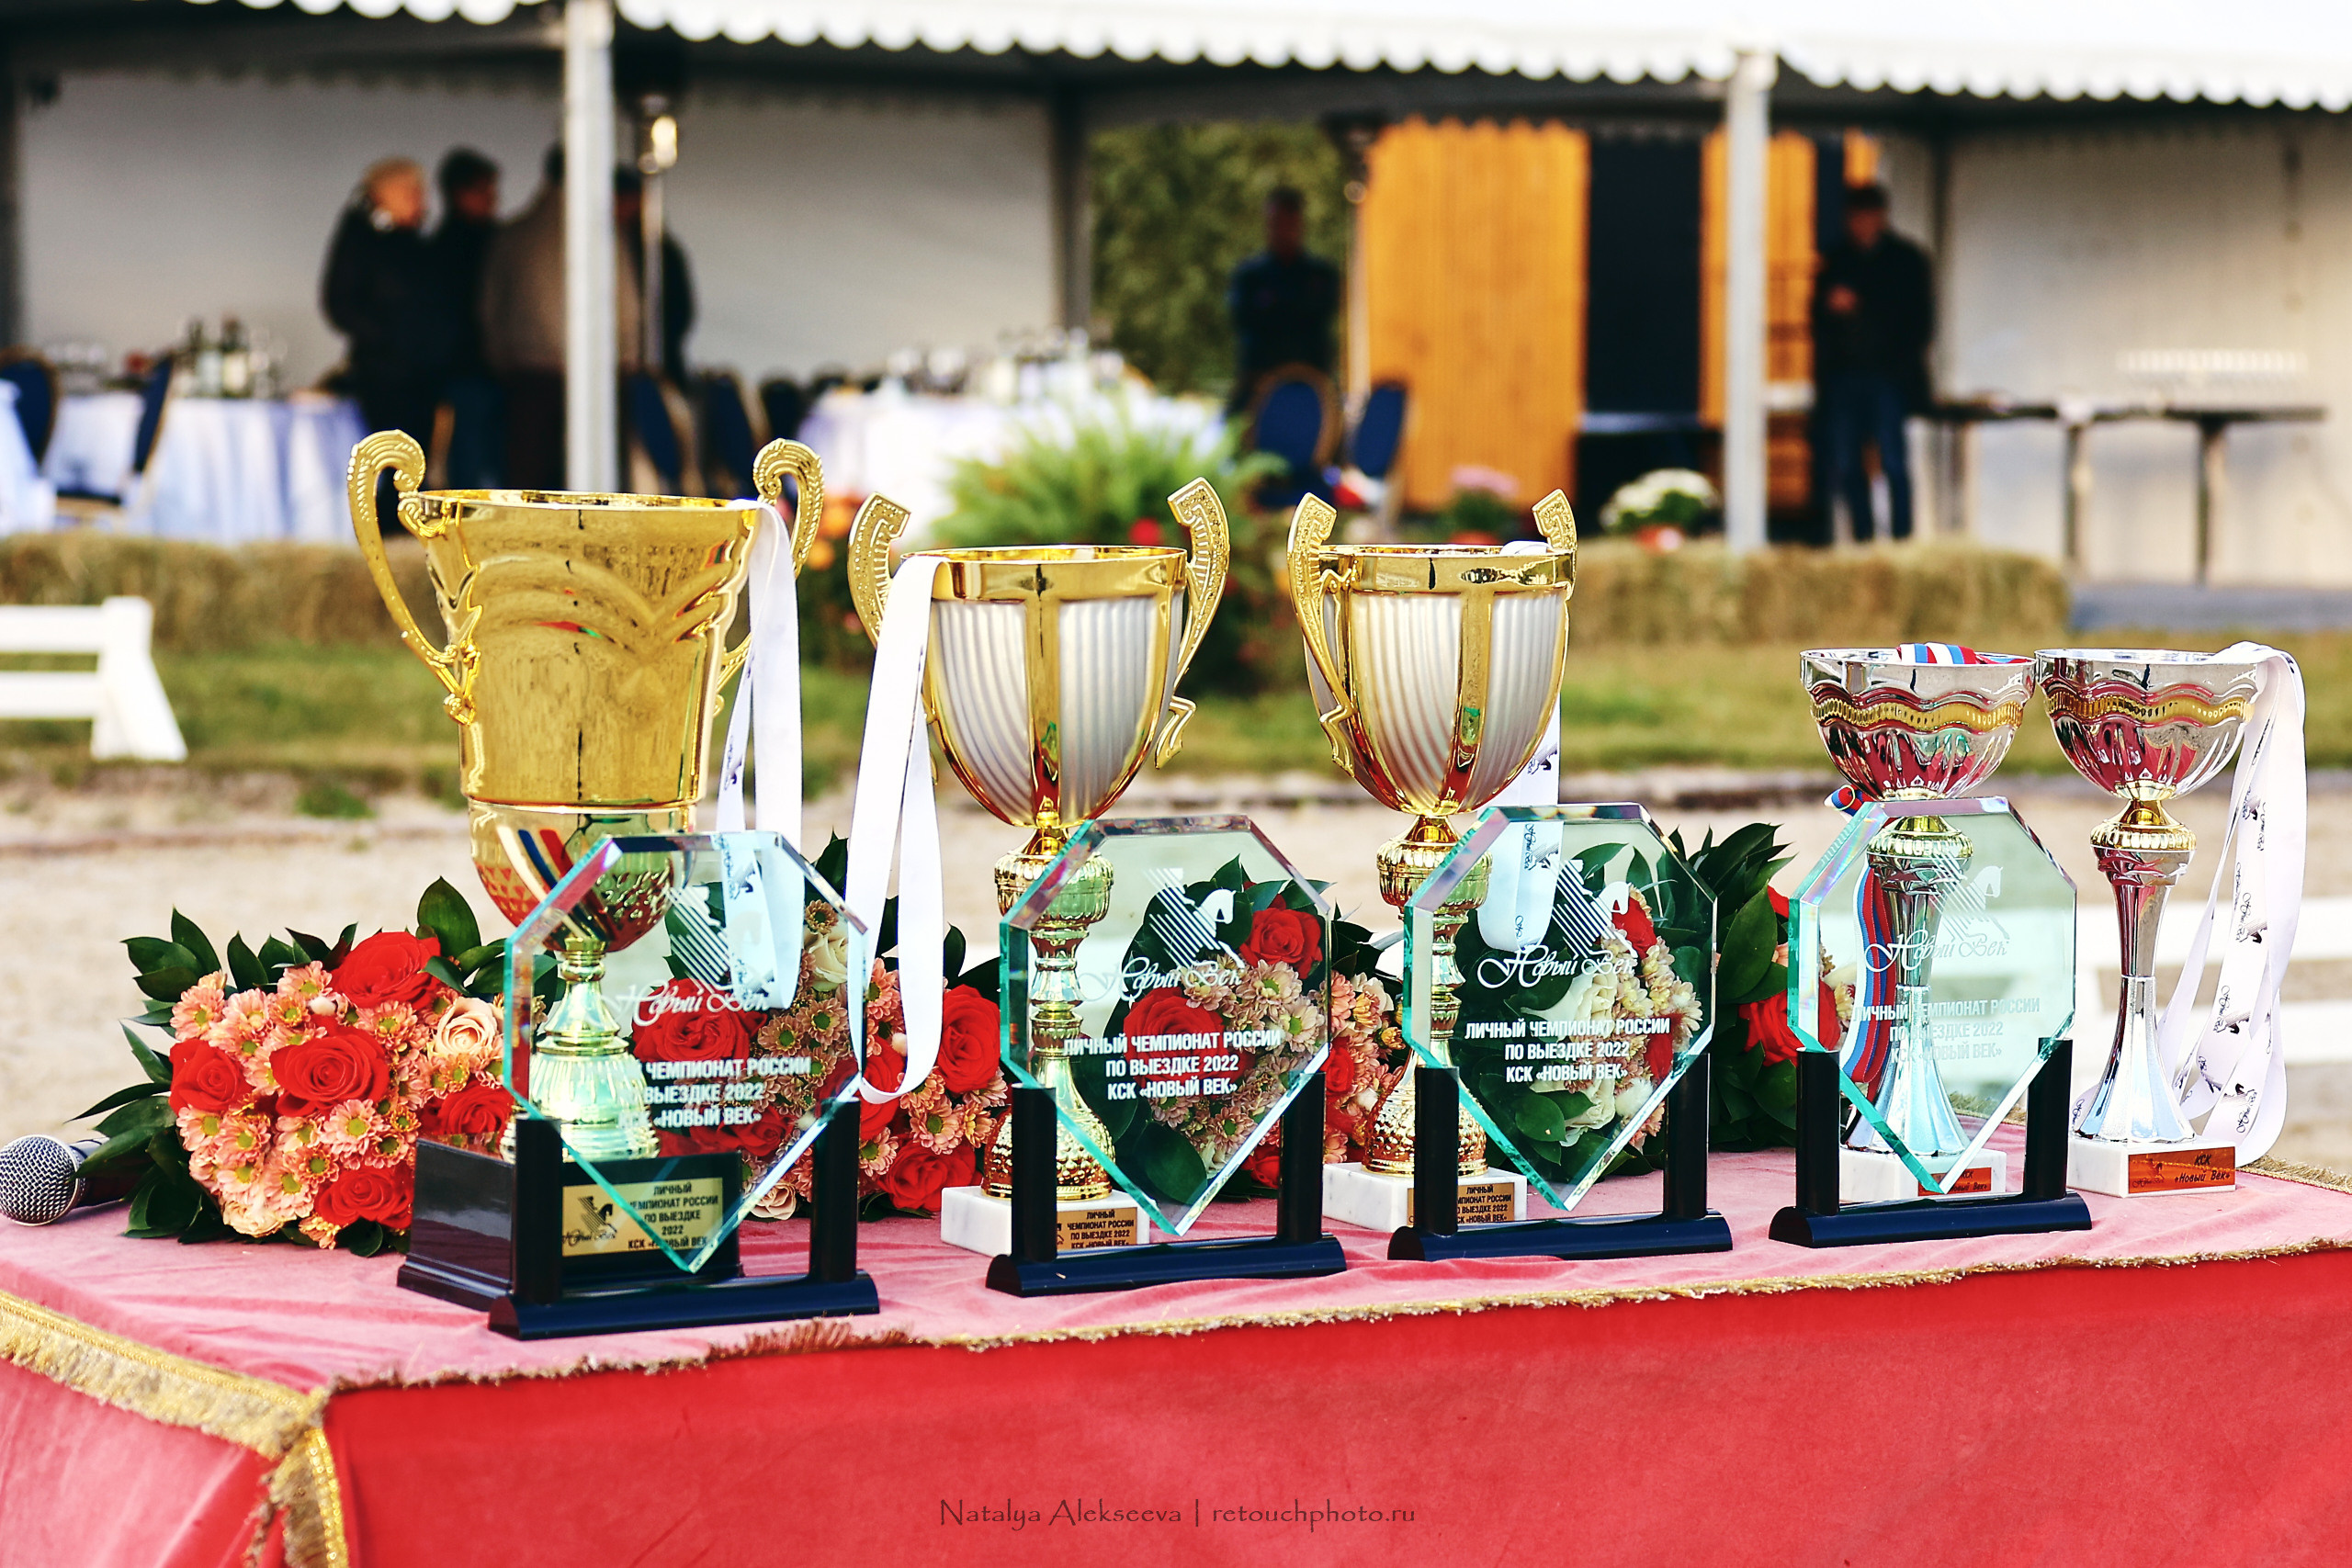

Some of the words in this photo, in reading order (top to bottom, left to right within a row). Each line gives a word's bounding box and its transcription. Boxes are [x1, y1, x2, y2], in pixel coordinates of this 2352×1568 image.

[1477, 944, 1579, 988] Новый
[1581, 950, 1637, 975] Век
[1853, 1001, 1908, 1021] ЛИЧНЫЙ
[1914, 999, 1988, 1018] ЕМПИОНАТ
[1990, 998, 2040, 1015] РОССИИ
[1464, 1019, 1526, 1039] ЛИЧНЫЙ
[1530, 1020, 1611, 1038] ЧЕМПИОНАТ
[1615, 1018, 1670, 1034] РОССИИ
[1889, 1026, 1907, 1042] ПО
[1973, 1021, 2004, 1037] 2022
[1063, 1032, 1128, 1056] ЛИЧНЫЙ
[1131, 1032, 1220, 1054] ЧЕМПИОНАТ
[1223, 1029, 1282, 1048] РОССИИ
[1505, 1043, 1524, 1060] ПО
[1527, 1041, 1594, 1061] ВЫЕЗДКЕ
[1596, 1041, 1630, 1057] 2022
[645, 1058, 743, 1080] ЧЕМПИОНАТ
[746, 1056, 812, 1075] РОССИИ
[1105, 1058, 1126, 1077] ПО
[1129, 1055, 1200, 1077] ВЫЕЗДКЕ
[1203, 1055, 1239, 1072] 2022
[1506, 1066, 1533, 1082] КСК
[1535, 1062, 1593, 1082] «НОВЫЙ
[1595, 1063, 1628, 1079] ВЕК»
[643, 1083, 721, 1104] ВЫЕЗДКЕ
[723, 1082, 765, 1100] 2022
[1107, 1082, 1136, 1100] КСК
[1139, 1076, 1201, 1098] «НОВЫЙ
[1203, 1077, 1238, 1095] ВЕК»
[653, 1105, 721, 1128] «НОВЫЙ
[723, 1106, 763, 1126] ВЕК»
[653, 1183, 692, 1196] ЛИЧНЫЙ
[1457, 1196, 1487, 1204] МПИОНАТ
[1487, 1194, 1511, 1202] РОССИИ
[1466, 1185, 1494, 1194] ЛИЧНЫЙ
[683, 1195, 718, 1207] РОССИИ
[1462, 1204, 1491, 1213] ВЫЕЗДКЕ
[659, 1210, 701, 1223] ВЫЕЗДКЕ
[1086, 1209, 1115, 1220] ЛИЧНЫЙ
[662, 1225, 684, 1235] 2022
[1067, 1221, 1107, 1230] ЧЕМПИОНАТ
[1108, 1220, 1134, 1228] РОССИИ
[1070, 1232, 1080, 1240] ПО
[1080, 1230, 1113, 1239] ВЫЕЗДКЕ
[628, 1239, 645, 1249] КСК
[691, 1235, 707, 1247] ВЕК
